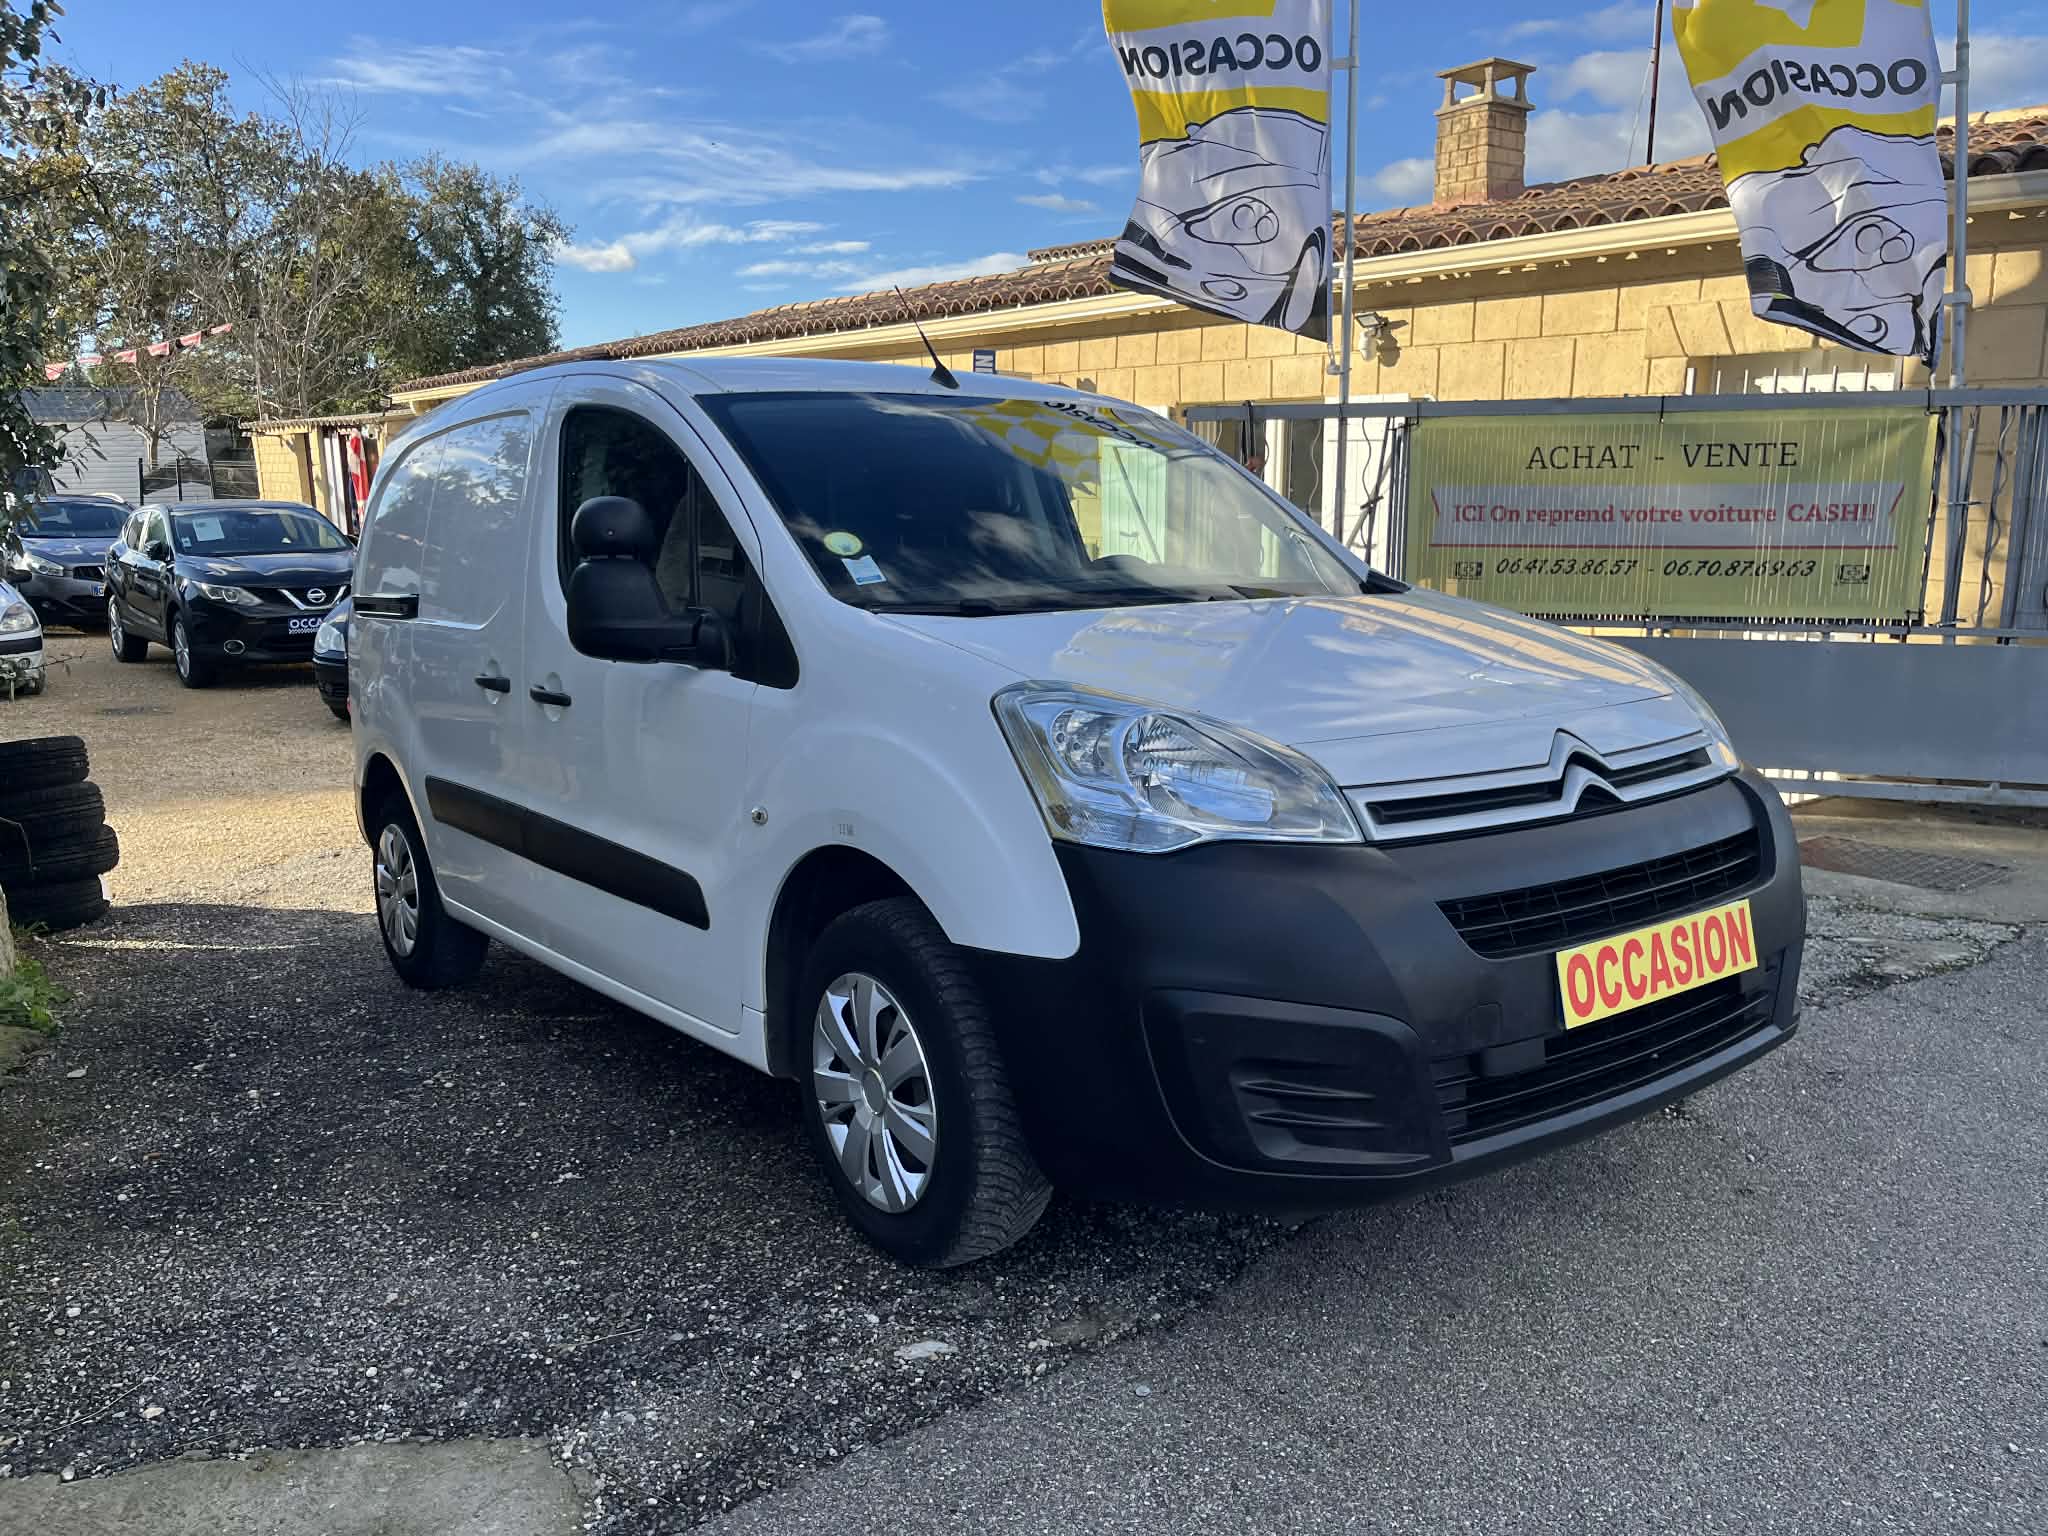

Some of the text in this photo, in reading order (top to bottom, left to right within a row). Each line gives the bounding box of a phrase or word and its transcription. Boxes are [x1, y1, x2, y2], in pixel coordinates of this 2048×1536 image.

[1525, 444, 1640, 470] ACHAT
[1680, 442, 1799, 468] VENTE
[1454, 504, 1486, 523] ICI
[1490, 504, 1521, 523] On
[1525, 504, 1615, 527] reprend
[1620, 506, 1683, 523] votre
[1689, 503, 1777, 523] voiture
[1566, 908, 1751, 1018] OCCASION
